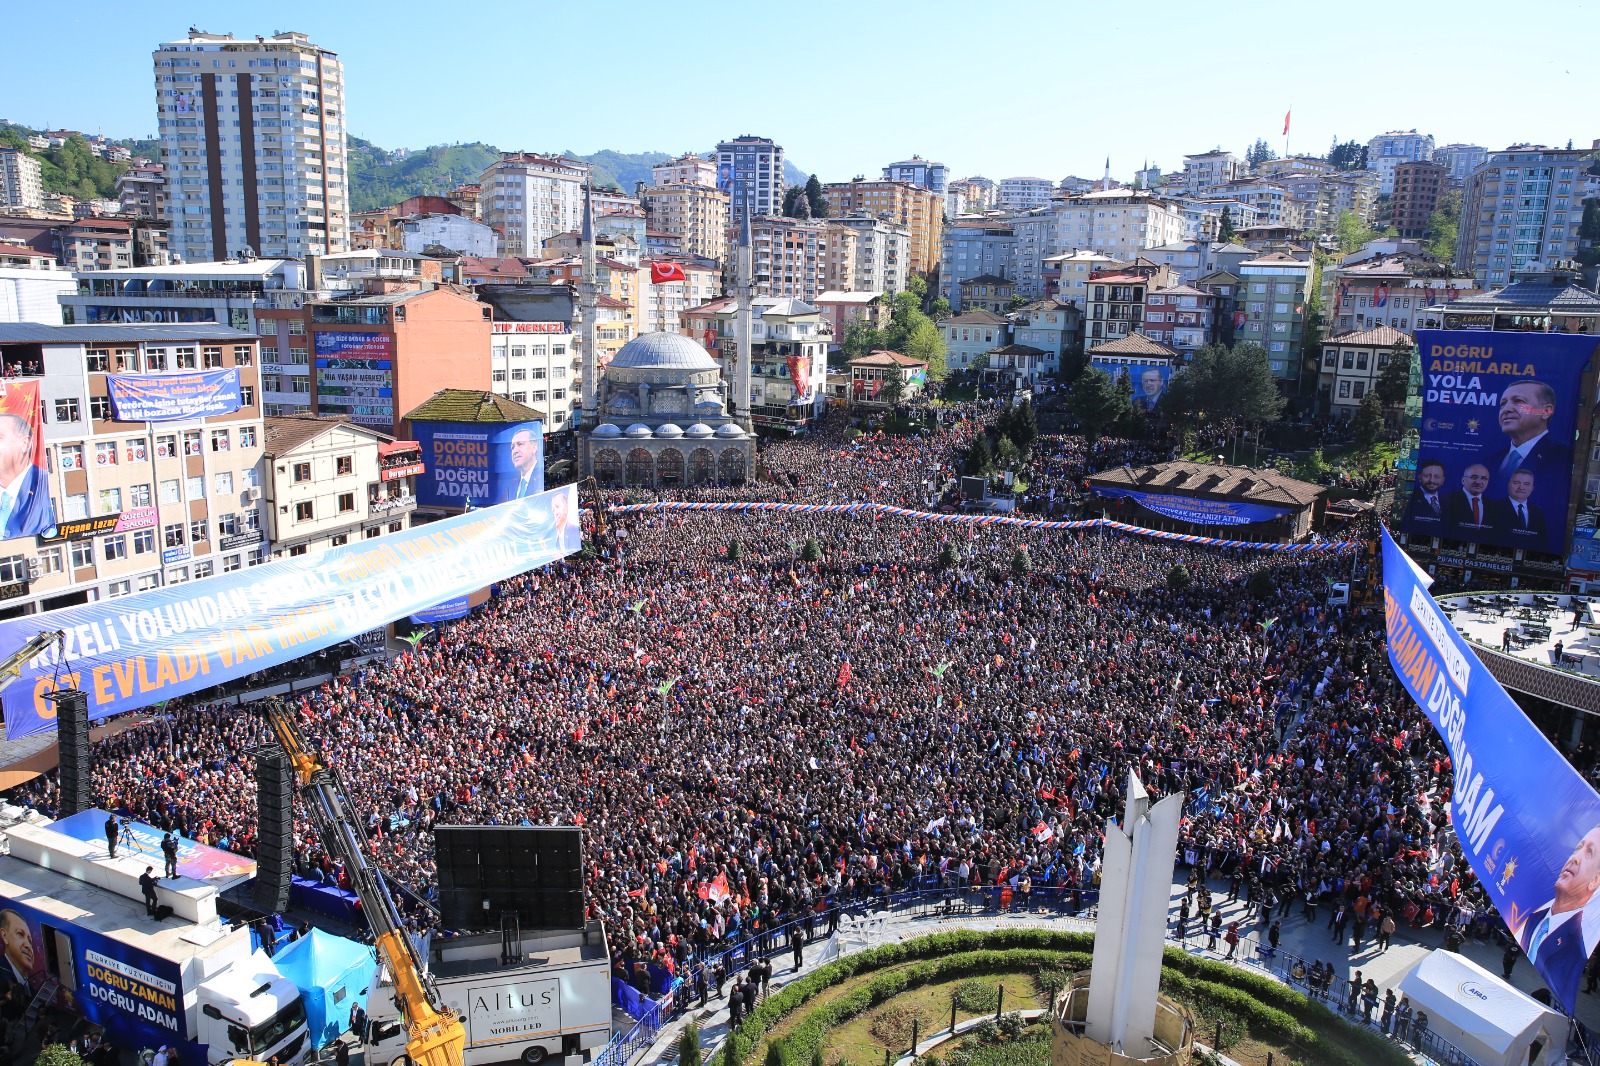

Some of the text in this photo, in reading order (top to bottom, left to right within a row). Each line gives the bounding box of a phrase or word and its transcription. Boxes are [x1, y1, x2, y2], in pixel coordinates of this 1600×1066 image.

[494, 322, 564, 332] TIP MERKEZİ
[1431, 344, 1493, 359] DOĞRU
[1430, 360, 1536, 376] ADIMLARLA
[324, 372, 384, 382] NİA YAŞAM MERKEZİ
[1429, 374, 1481, 389] YOLA
[1427, 390, 1497, 406] DEVAM
[144, 406, 181, 416] bozacak
[434, 440, 488, 454] DOĞRU
[435, 454, 488, 467] ZAMAN
[389, 469, 406, 478] Burger
[435, 468, 488, 483] DOĞRU
[437, 482, 488, 497] ADAM
[121, 510, 156, 521] GÜZELLİK
[1222, 515, 1251, 524] ATTINIZ
[60, 519, 118, 539] Efsane Lazer
[123, 519, 154, 529] SALONU
[1465, 559, 1512, 571] PASTANELERİ
[120, 584, 250, 646] YOLUNDAN
[338, 544, 399, 584] MÜHRÜ
[93, 634, 210, 706] EVLADI
[212, 622, 274, 668] VAR
[270, 602, 337, 650] İKEN
[1391, 614, 1438, 699] ZAMAN
[90, 953, 172, 991] TÜRKİYE YÜZYILI İÇİN
[87, 964, 176, 1011] DOĞRU ZAMAN
[1469, 988, 1488, 1000] AFAD
[90, 983, 178, 1031] DOĞRU ADAM
[474, 991, 551, 1013] Altus
[490, 1022, 542, 1035] MOBİL LED
